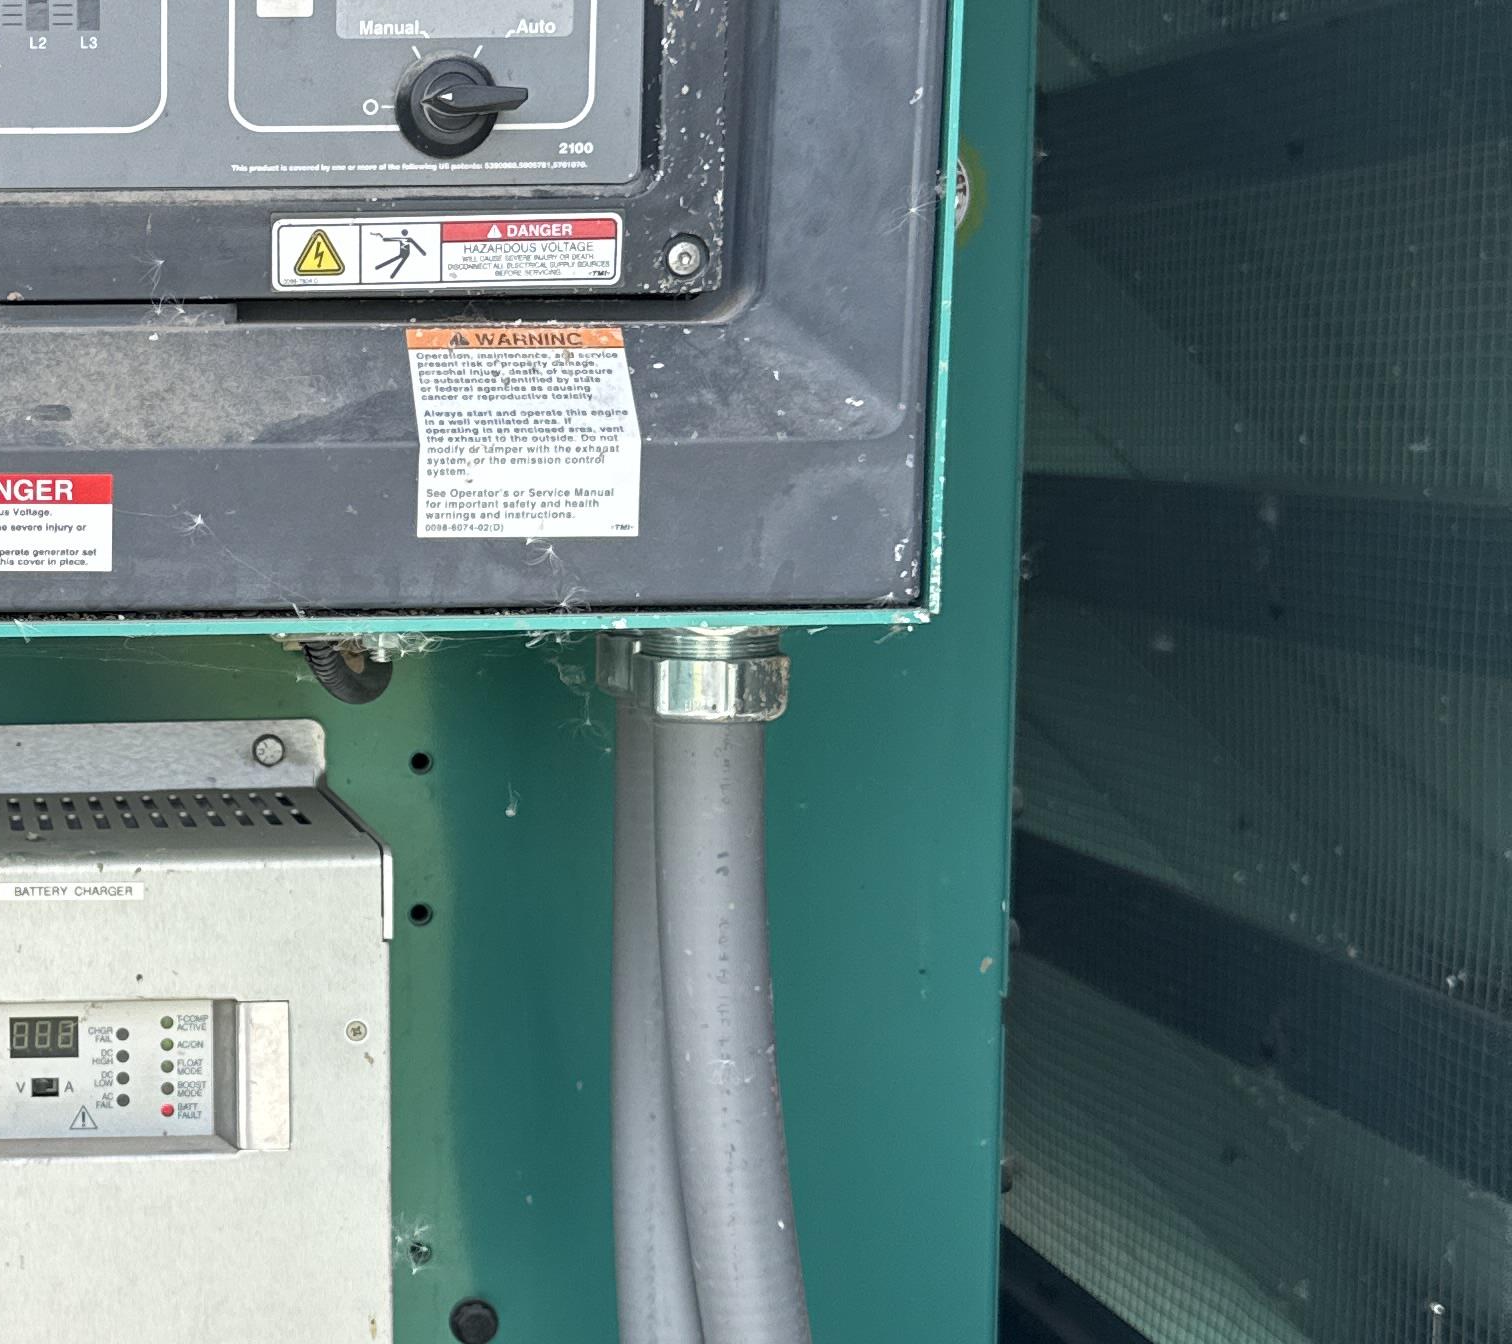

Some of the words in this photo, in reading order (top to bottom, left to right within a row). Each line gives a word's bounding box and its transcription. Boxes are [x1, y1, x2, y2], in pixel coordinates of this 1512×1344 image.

[359, 21, 419, 35] Manual
[516, 19, 557, 35] Auto
[29, 37, 47, 50] L2
[80, 37, 98, 50] L3
[558, 142, 594, 154] 2100
[507, 223, 573, 239] DANGER
[463, 243, 537, 254] HAZARDOUS
[541, 241, 594, 252] VOLTAGE
[426, 489, 446, 497] See
[450, 488, 509, 499] Operator's
[528, 488, 570, 497] Service
[574, 488, 614, 497] Manual
[426, 500, 441, 509] for
[445, 500, 499, 510] important
[502, 500, 536, 510] safety
[540, 500, 561, 508] and
[565, 500, 599, 508] health
[13, 508, 53, 518] Voltage.
[425, 511, 476, 521] warnings
[480, 511, 501, 519] and
[504, 511, 576, 519] instructions.
[45, 523, 74, 533] injury
[33, 548, 79, 558] generator
[82, 548, 97, 556] set
[48, 558, 57, 566] in
[59, 558, 88, 567] place.
[14, 886, 67, 897] BATTERY
[74, 886, 133, 897] CHARGER
[177, 1023, 206, 1031] ACTIVE
[16, 1082, 26, 1093] V
[64, 1081, 74, 1092] A
[177, 1089, 203, 1097] MODE
[178, 1111, 202, 1119] FAULT
